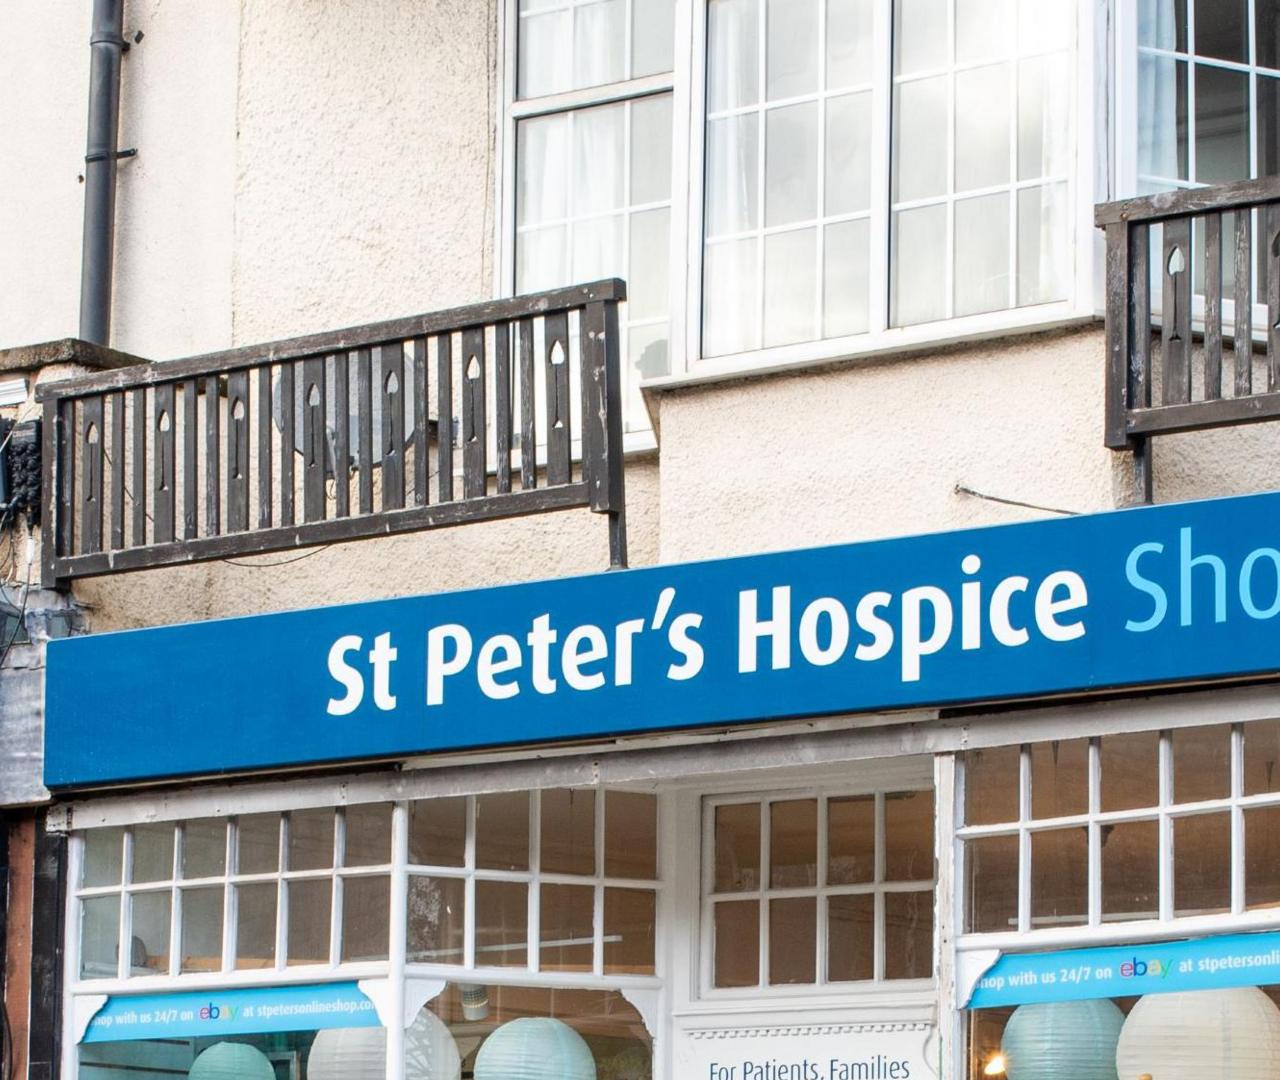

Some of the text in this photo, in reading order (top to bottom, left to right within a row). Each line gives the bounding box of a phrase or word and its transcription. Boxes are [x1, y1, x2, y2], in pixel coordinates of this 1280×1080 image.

[326, 633, 398, 717] St
[426, 588, 705, 706] Peter's
[736, 554, 1086, 682] Hospice
[976, 974, 1005, 991] hop
[1008, 972, 1037, 986] with
[1041, 972, 1056, 984] us
[1059, 966, 1090, 985] 24/7
[1096, 967, 1112, 979] on
[1120, 957, 1173, 980] ebay
[1179, 959, 1193, 973] at
[93, 1014, 113, 1028] hop
[115, 1013, 138, 1025] with
[140, 1013, 152, 1023] us
[154, 1009, 177, 1024] 24/7
[180, 1011, 194, 1021] on
[199, 1002, 239, 1022] ebay
[242, 1006, 254, 1017] at
